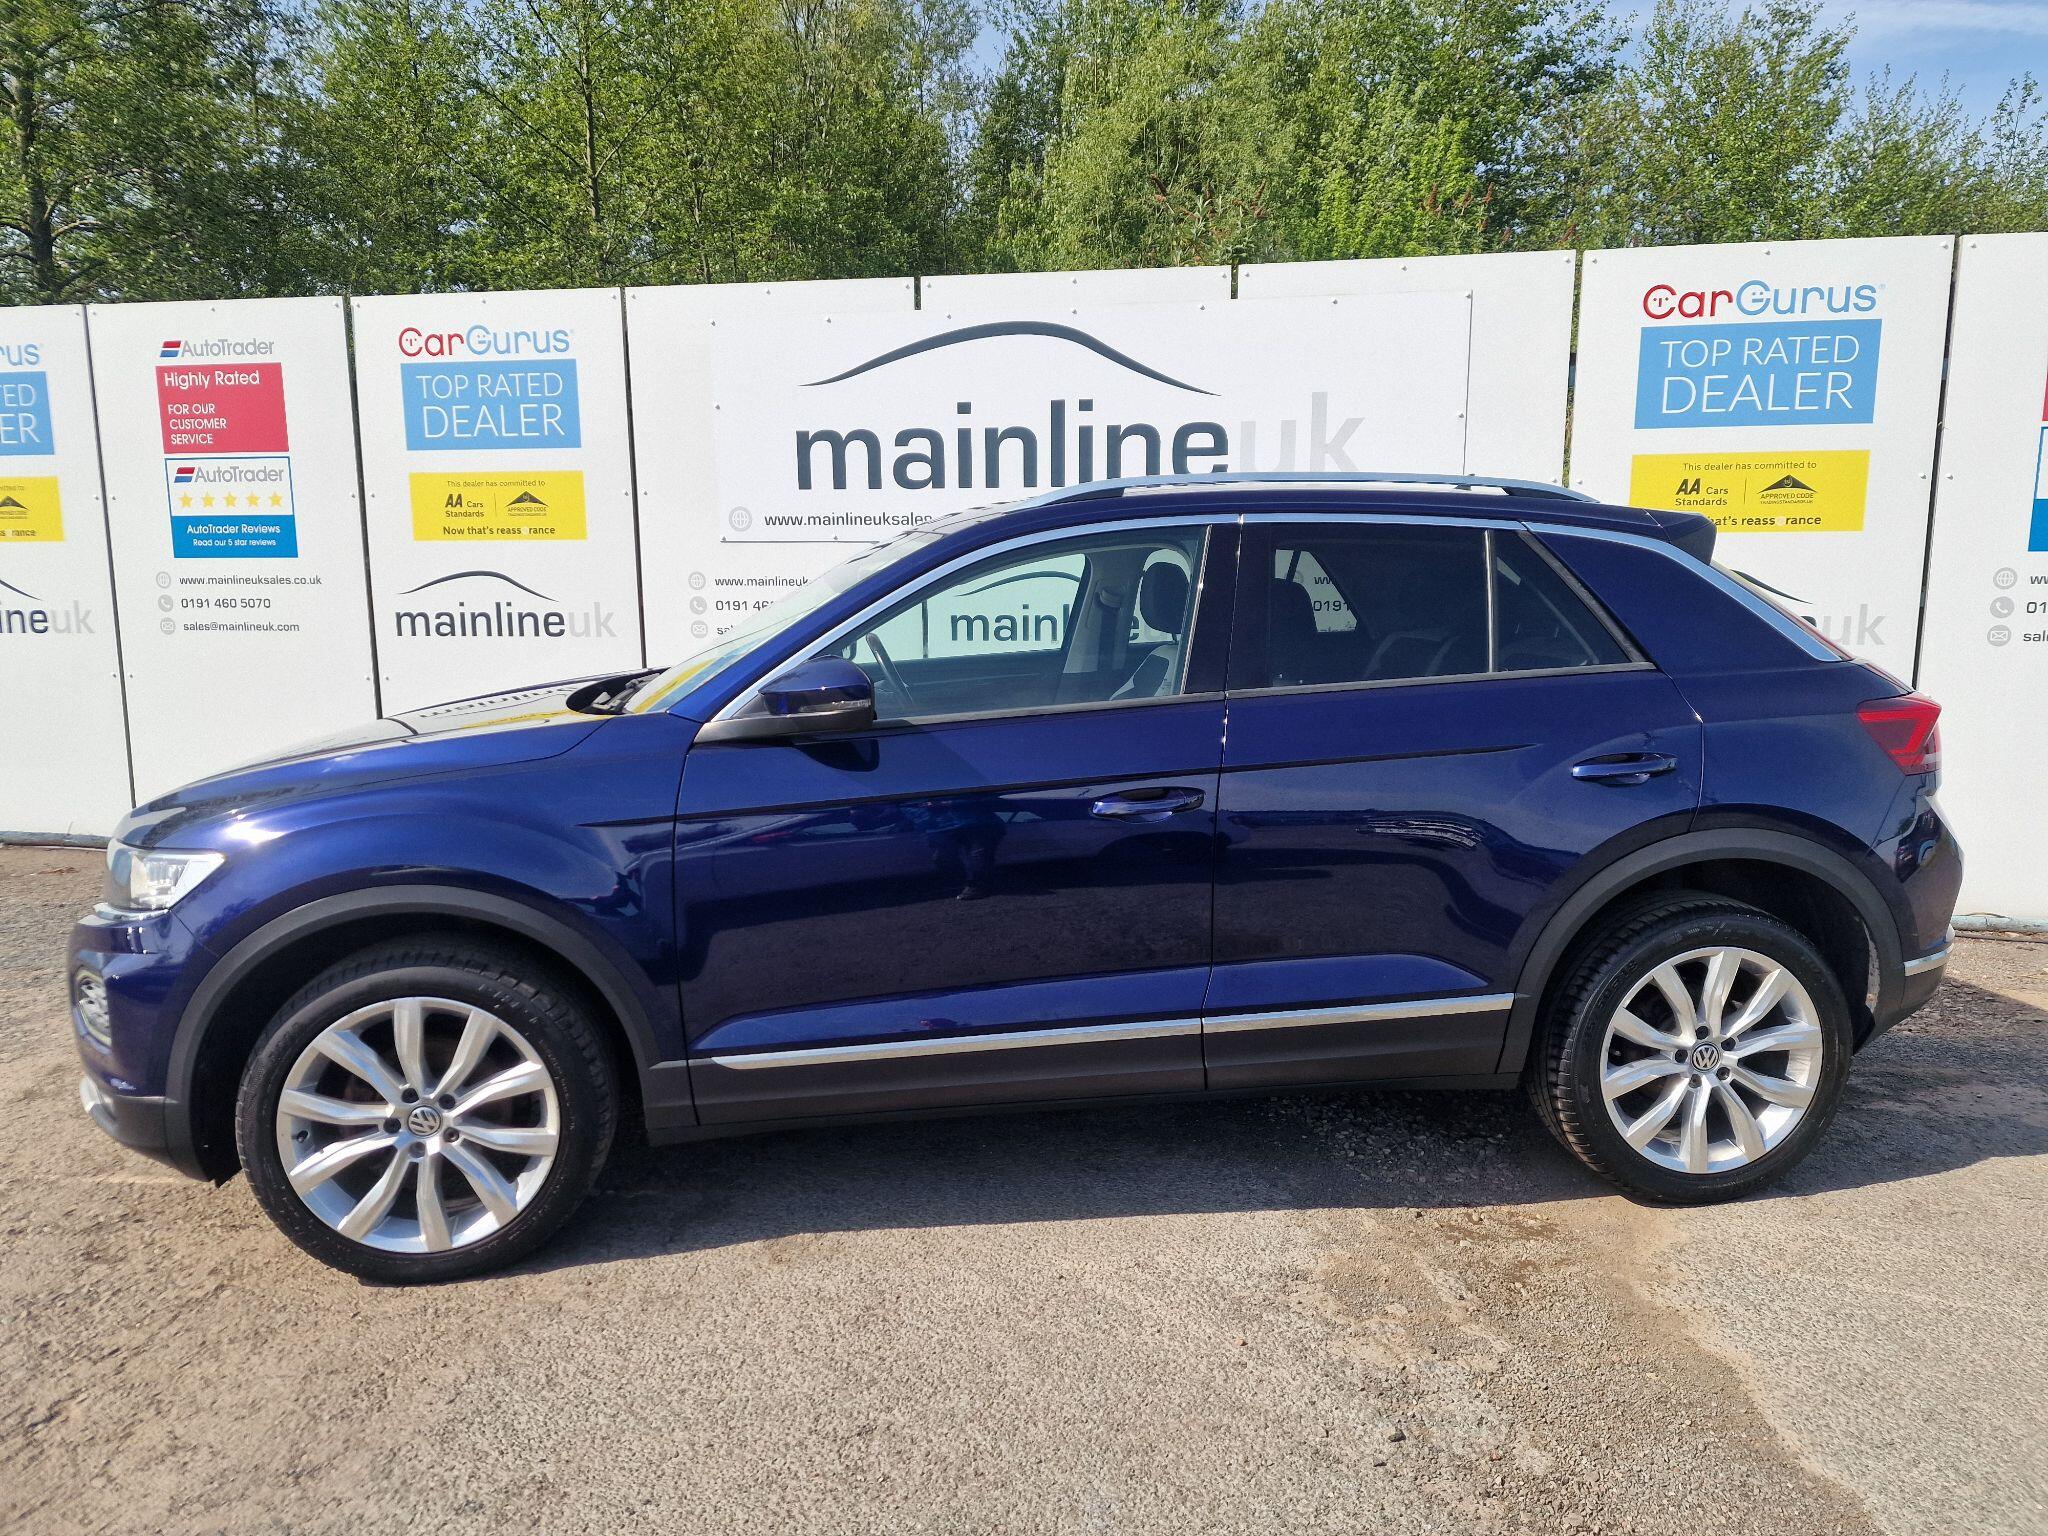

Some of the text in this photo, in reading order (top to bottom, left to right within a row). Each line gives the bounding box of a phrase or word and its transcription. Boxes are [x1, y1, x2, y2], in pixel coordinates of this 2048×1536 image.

[1643, 280, 1877, 319] CarGurus
[181, 337, 275, 357] AutoTrader
[399, 325, 569, 357] CarGurus
[1660, 335, 1860, 369] TOP RATED
[164, 370, 260, 389] Highly Rated
[416, 372, 563, 399] TOP RATED
[1661, 371, 1854, 414] DEALER
[167, 403, 216, 415] FOR OUR
[169, 418, 227, 430] CUSTOMER
[422, 404, 566, 438] DEALER
[170, 433, 214, 445] SERVICE
[1684, 460, 1817, 471] This dealer has committed to
[194, 466, 284, 483] AutoTrader
[447, 480, 461, 488] This
[462, 480, 484, 488] dealer
[500, 479, 537, 487] committed
[538, 479, 546, 487] to
[1675, 478, 1729, 495] AA Cars
[445, 493, 464, 508] AA
[1674, 497, 1728, 506] Standards
[445, 510, 485, 518] Standards
[1741, 516, 1822, 526] reassrance
[186, 523, 281, 534] AutoTrader Reviews
[442, 525, 556, 535] Now that's reassrance
[192, 538, 277, 547] Read our 5 star reviews
[178, 574, 323, 586] www.mainlineuksales.co.uk
[180, 598, 272, 609] 0191 460 5070
[715, 600, 748, 611] 0191
[183, 621, 300, 632] sales@mainlineuk.com
